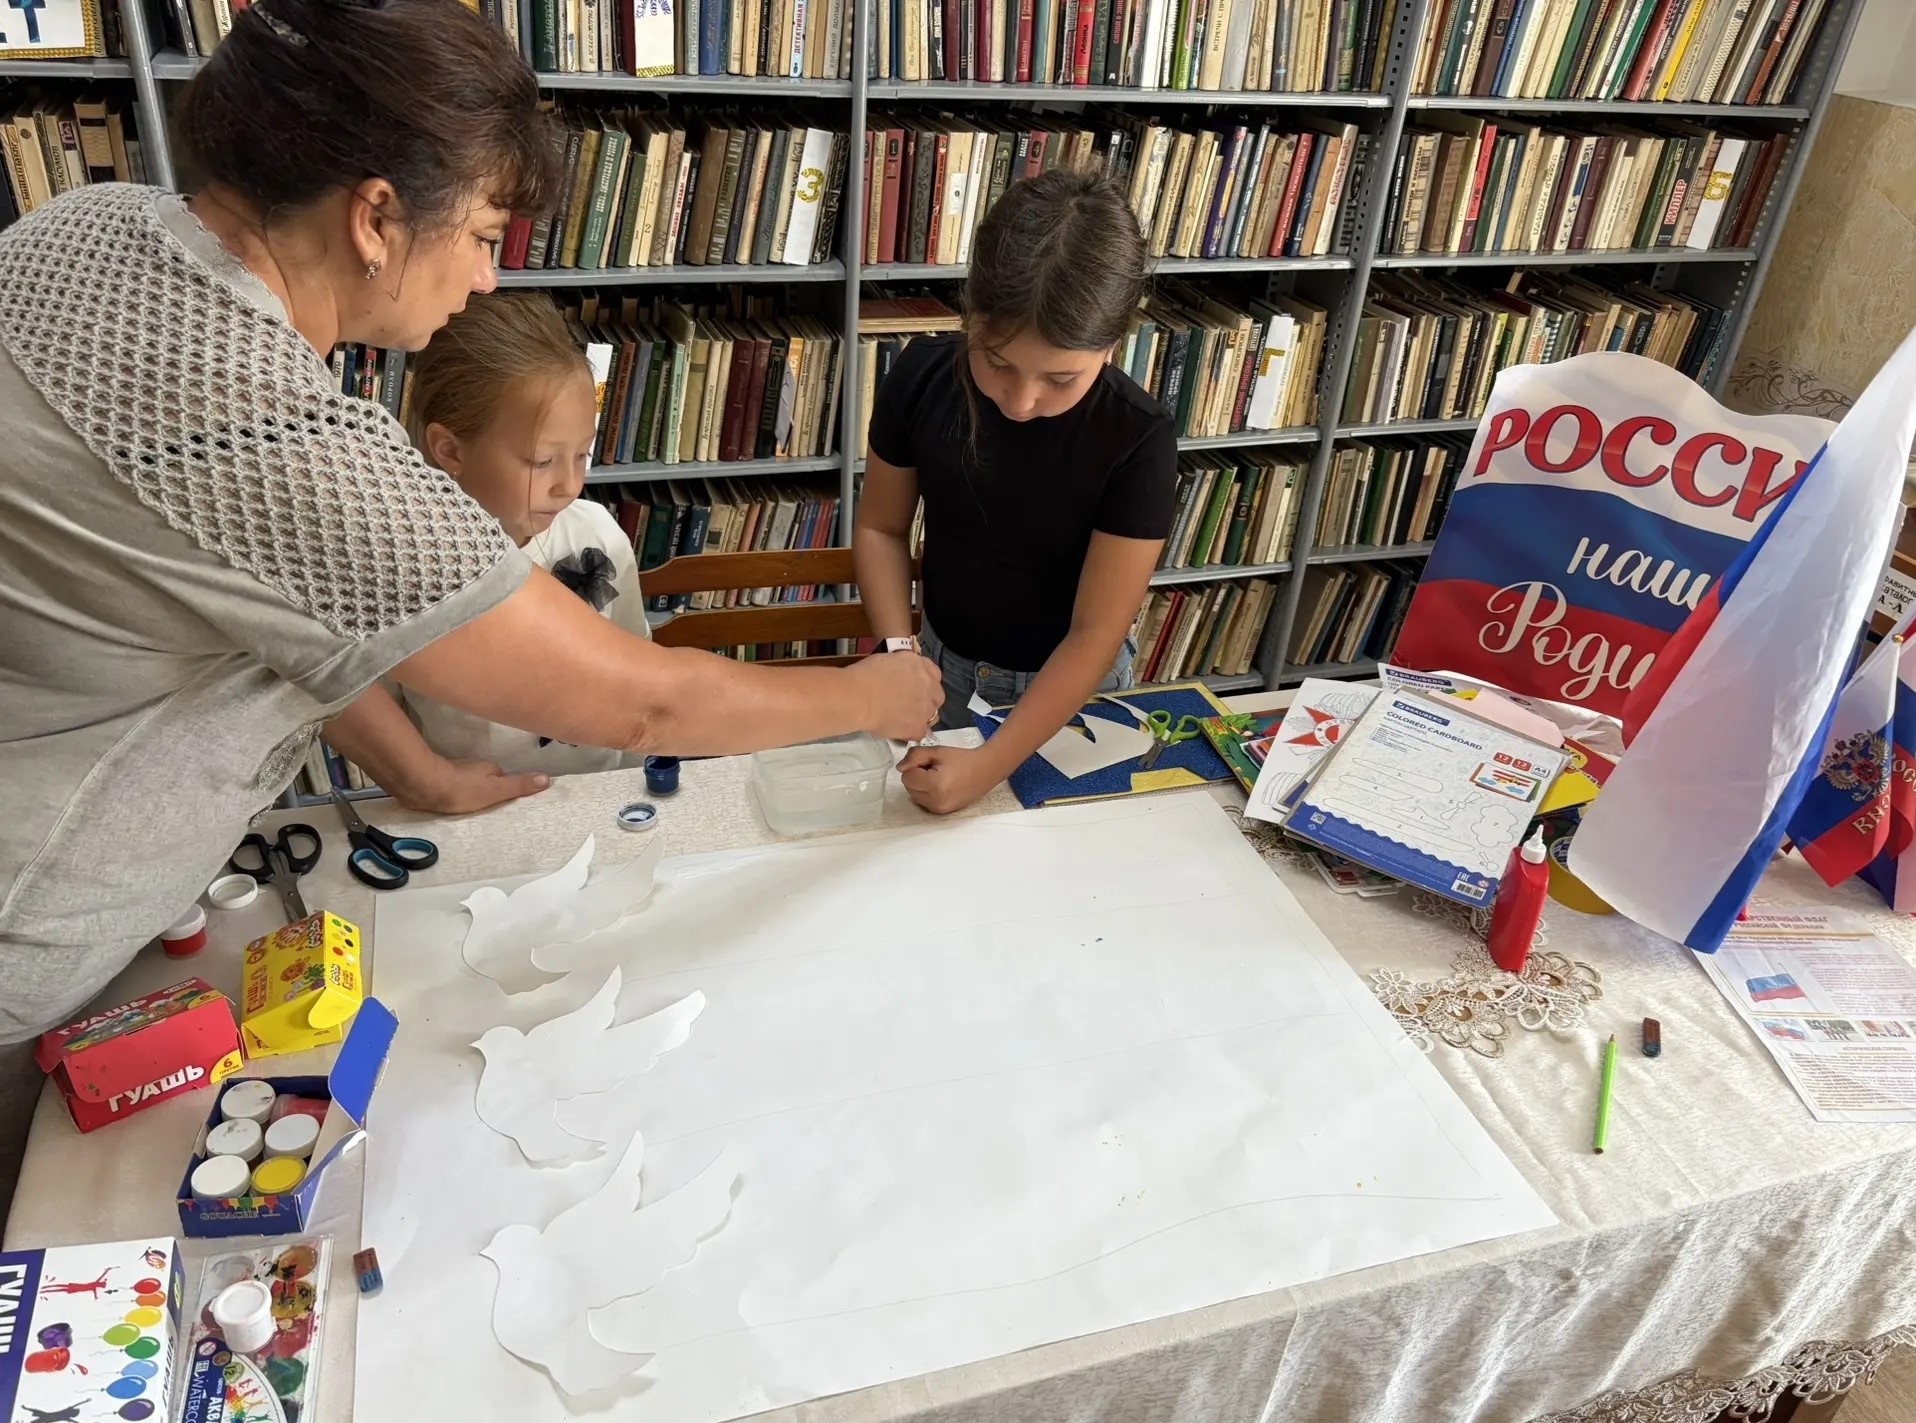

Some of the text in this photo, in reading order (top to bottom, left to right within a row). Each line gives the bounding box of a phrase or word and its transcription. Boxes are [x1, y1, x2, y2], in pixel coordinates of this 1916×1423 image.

[793, 3, 803, 53] ДЕТЕКТИВНАЯ
[1212, 19, 1222, 51] ВСТРЕЧИ
[1662, 179, 1688, 226] КИЛЛЕР
[1399, 672, 1446, 686] BRAUBERG
[1386, 711, 1427, 729] COLORED
[1427, 727, 1483, 751] CARDBOARD
[1405, 705, 1443, 724] BRAUBERG
[57, 999, 147, 1036] ГУАШЬ
[223, 1058, 233, 1068] 6
[108, 1064, 205, 1113] ГУАШЬ
[206, 1397, 223, 1423] АКВ
